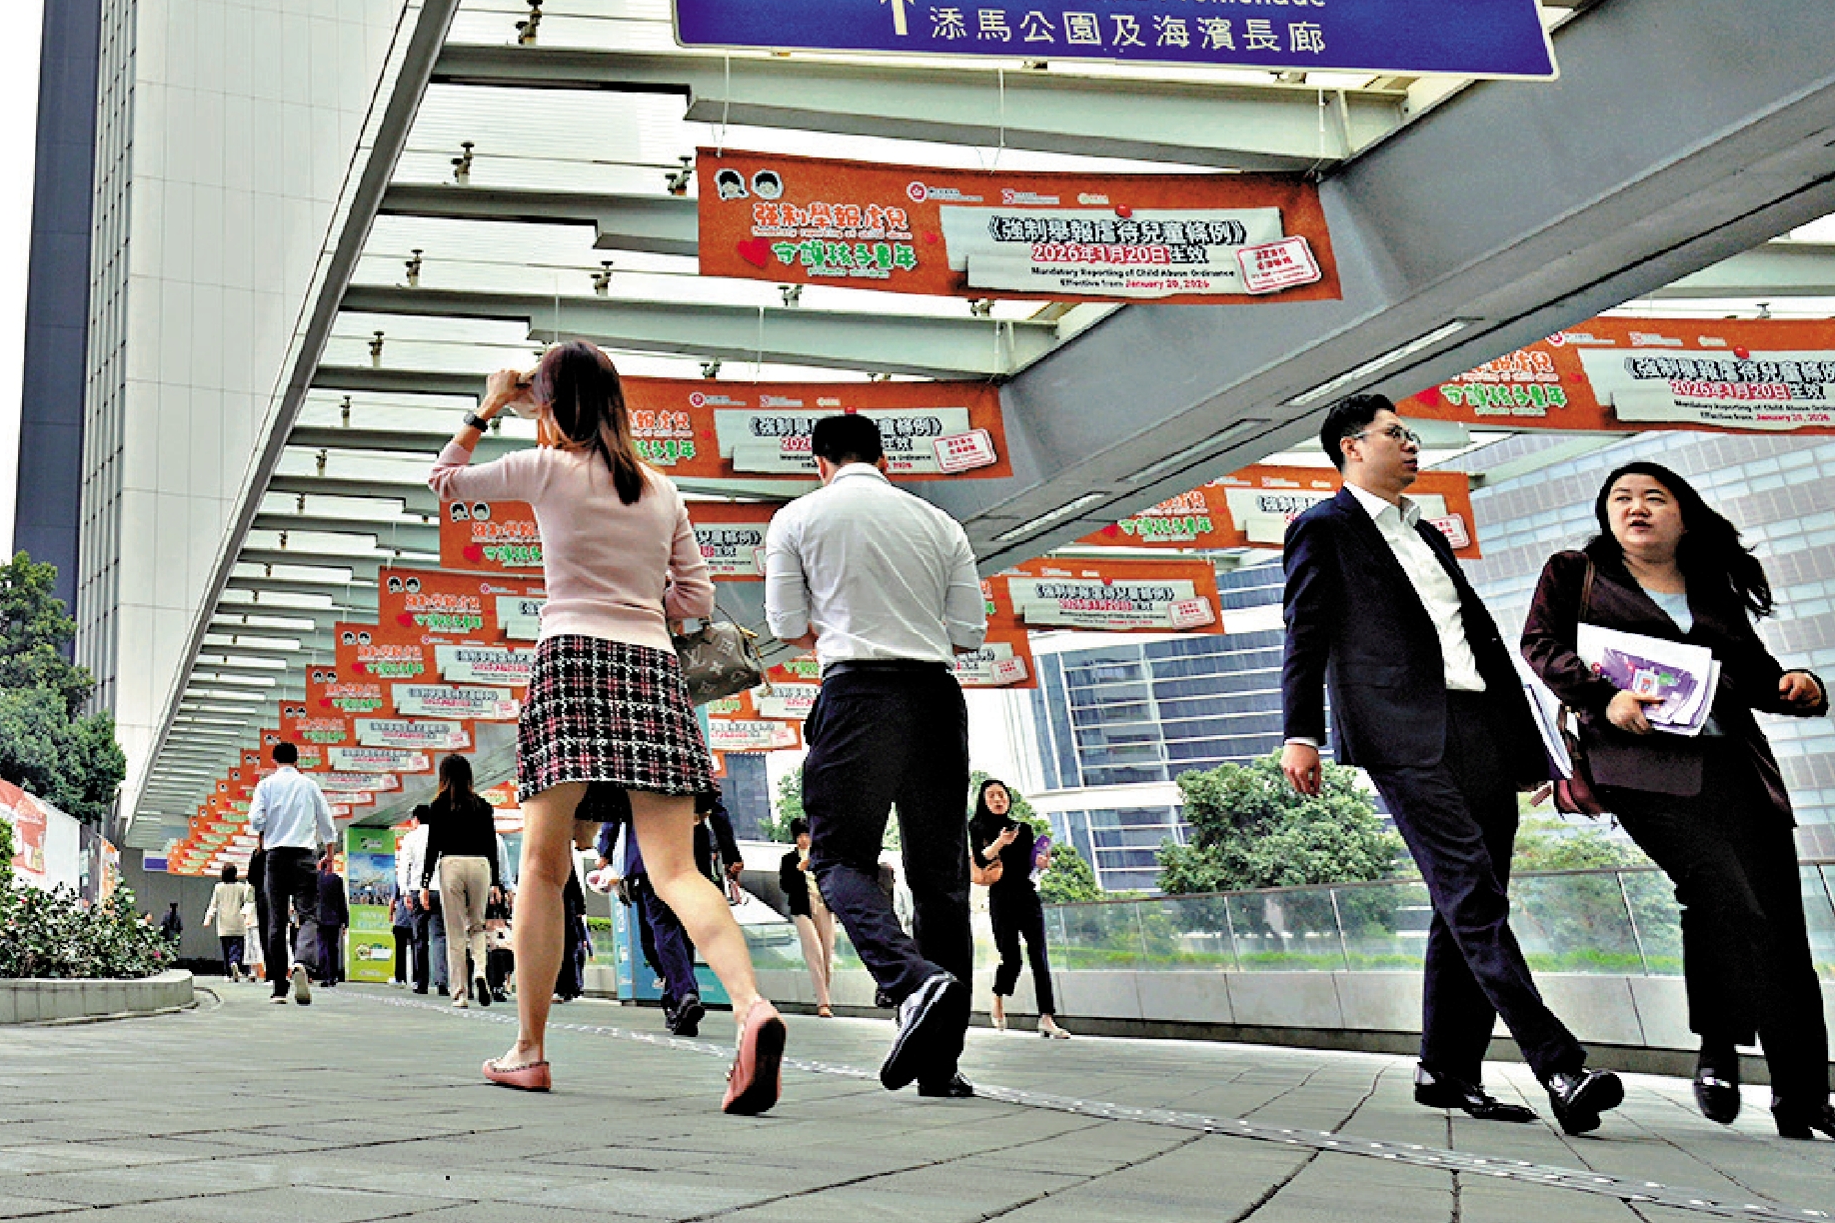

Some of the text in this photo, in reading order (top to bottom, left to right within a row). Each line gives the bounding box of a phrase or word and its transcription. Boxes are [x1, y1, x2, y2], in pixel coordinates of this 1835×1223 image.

[929, 5, 1326, 55] 添馬公園及海濱長廊
[1031, 243, 1209, 265] 2026年1月20日生效
